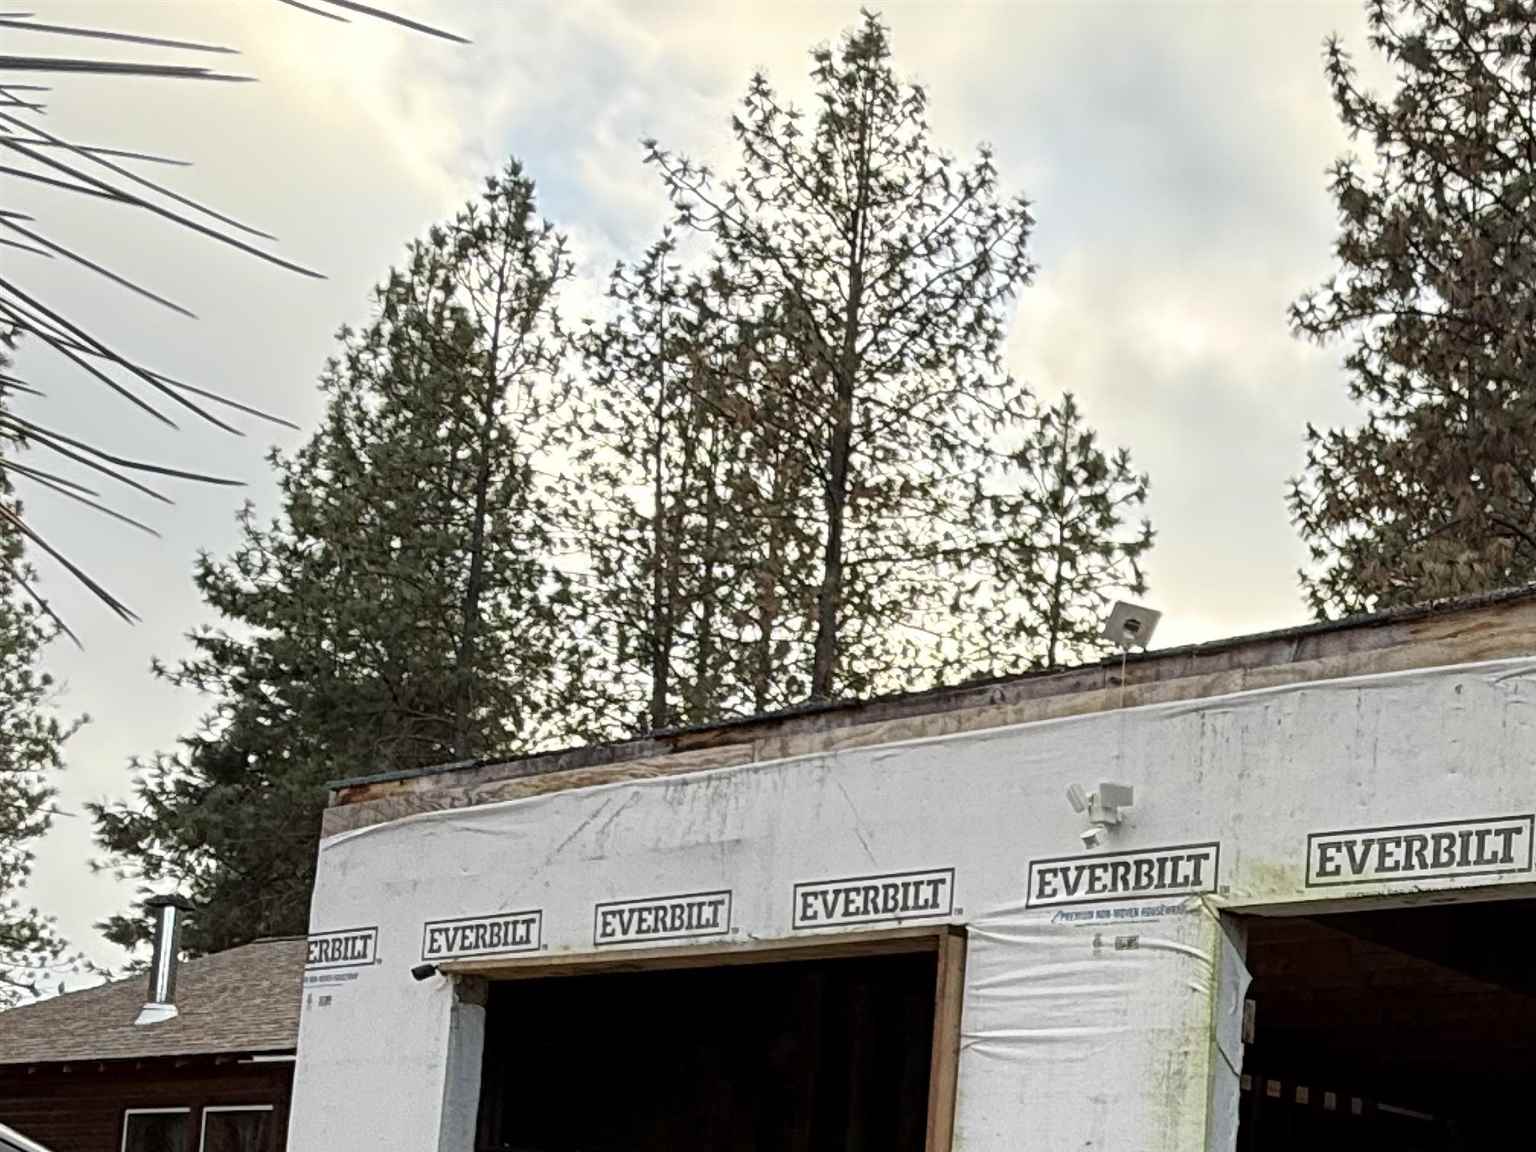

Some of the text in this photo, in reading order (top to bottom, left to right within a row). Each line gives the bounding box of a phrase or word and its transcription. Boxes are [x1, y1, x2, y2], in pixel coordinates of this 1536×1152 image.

[1316, 826, 1523, 877] EVERBILT
[1035, 853, 1210, 899] EVERBILT
[600, 898, 725, 938] EVERBILT
[799, 878, 946, 921] EVERBILT
[305, 934, 373, 964] ERBILT
[427, 917, 537, 954] EVERBILT
